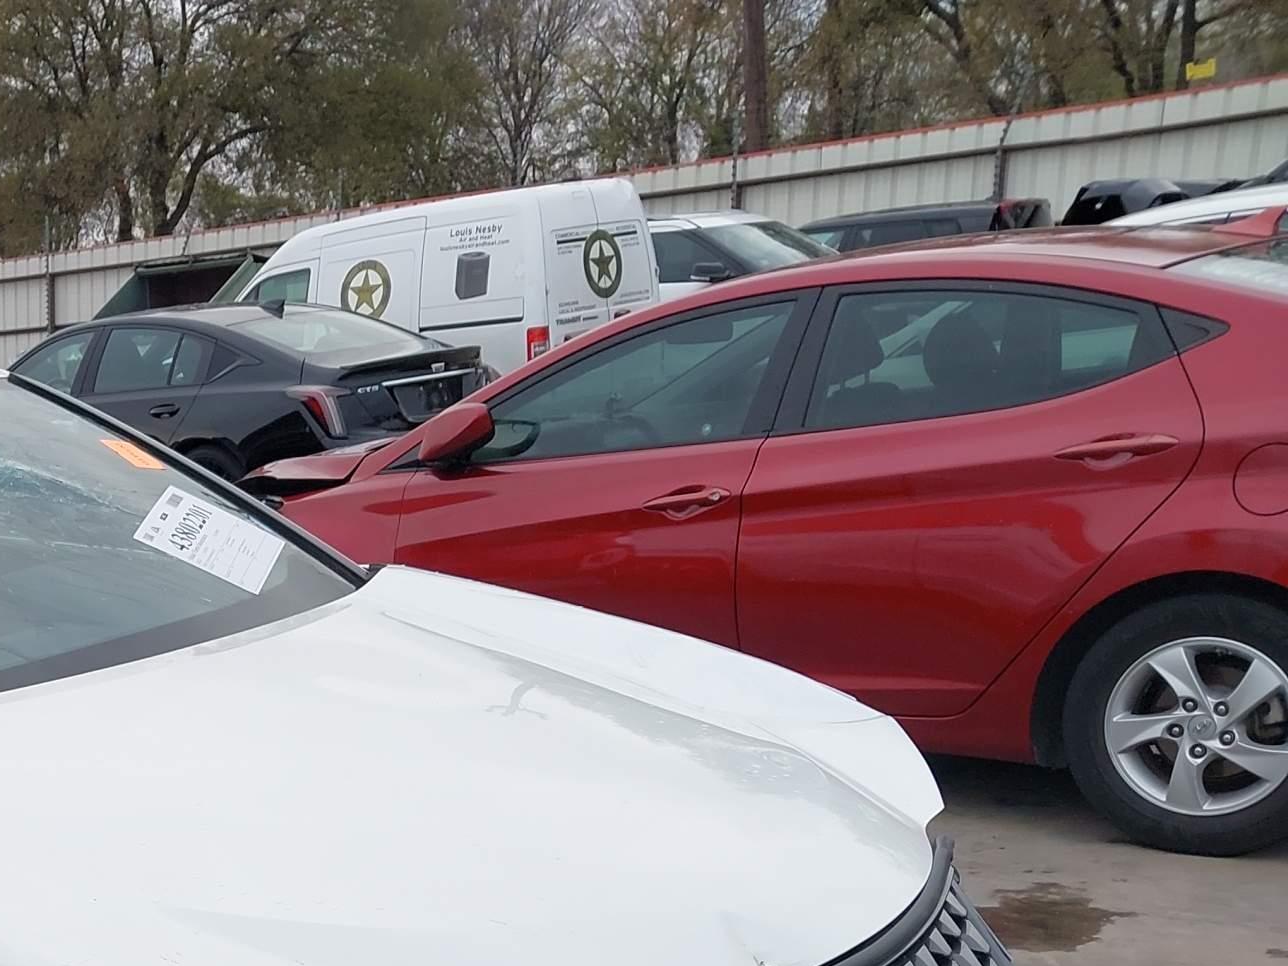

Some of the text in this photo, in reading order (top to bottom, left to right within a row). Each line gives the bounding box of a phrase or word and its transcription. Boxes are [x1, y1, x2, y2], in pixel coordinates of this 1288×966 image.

[450, 224, 503, 238] Louis Nesby
[168, 504, 213, 551] 43802201
